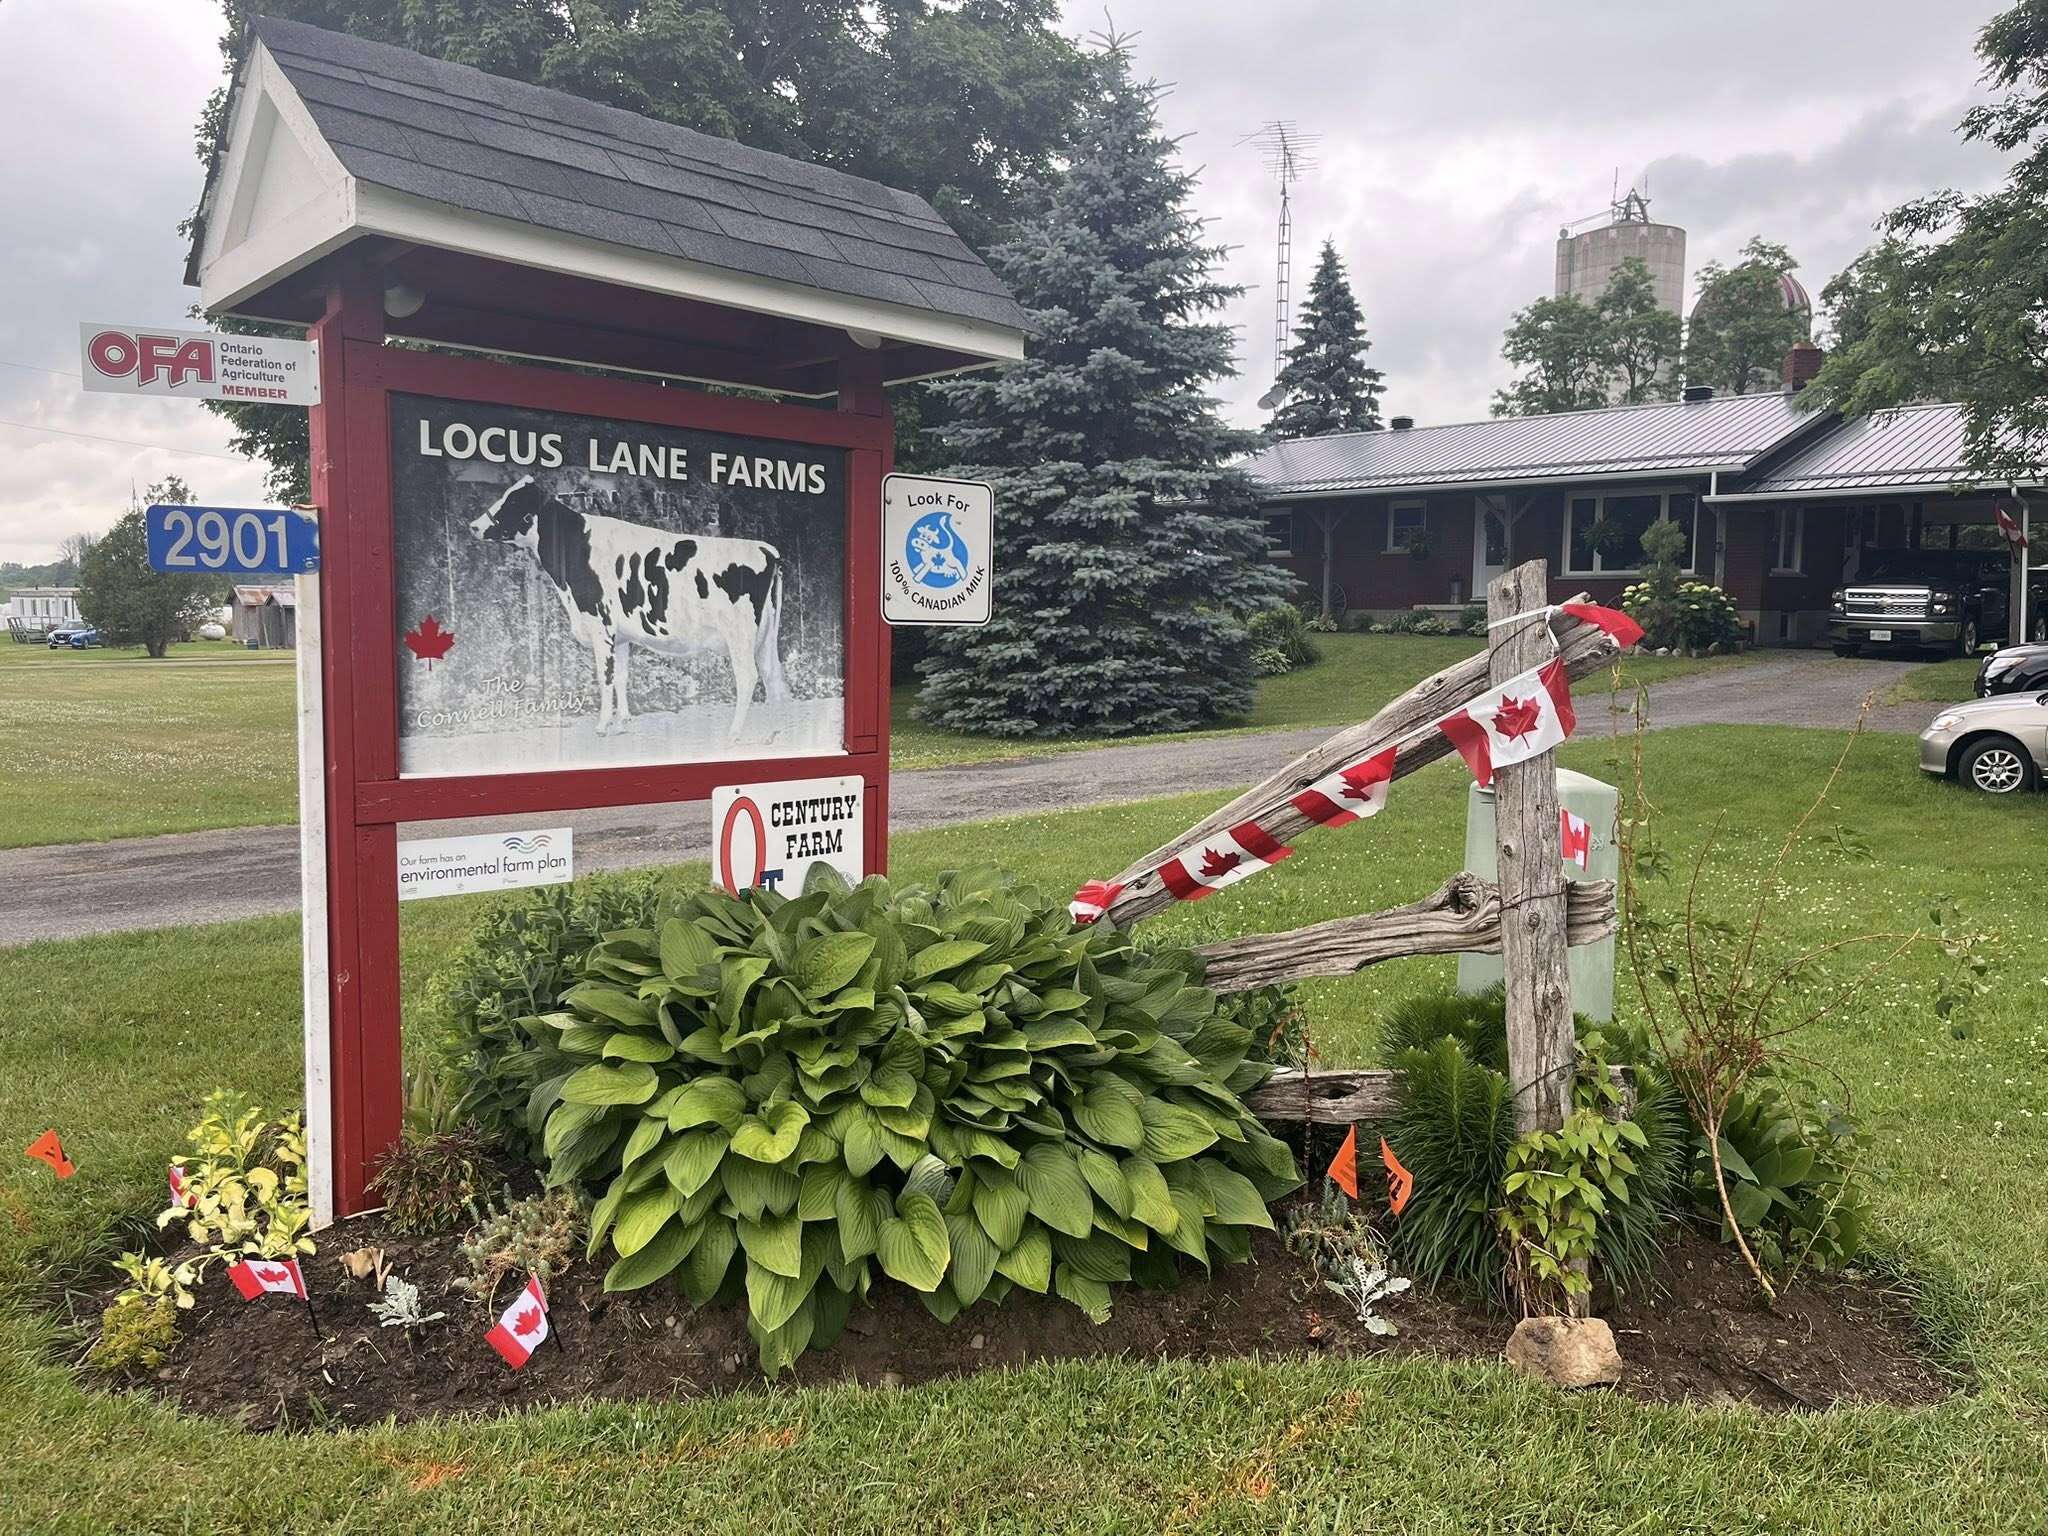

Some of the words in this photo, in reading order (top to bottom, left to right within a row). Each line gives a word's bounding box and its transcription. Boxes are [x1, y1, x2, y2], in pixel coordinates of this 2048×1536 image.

[88, 331, 216, 388] OFA
[220, 342, 263, 355] Ontario
[221, 355, 282, 370] Federation
[285, 361, 296, 371] of
[222, 368, 285, 383] Agriculture
[222, 385, 288, 399] MEMBER
[419, 419, 564, 468] LOCUS
[589, 438, 688, 480] LANE
[710, 452, 827, 494] FARMS
[907, 492, 943, 507] Look
[947, 494, 970, 512] For
[163, 510, 288, 568] 2901
[890, 559, 910, 595] 100%
[911, 592, 966, 611] CANADIAN
[967, 565, 985, 597] MILK
[482, 676, 525, 694] The
[417, 700, 506, 728] Connell
[513, 692, 586, 719] Family
[771, 795, 856, 827] CENTURY
[786, 829, 843, 859] FARM
[400, 856, 417, 866] Our
[419, 854, 438, 864] farm
[439, 853, 454, 863] has
[455, 854, 466, 862] an
[400, 858, 500, 883] environmental
[503, 856, 534, 873] farm
[538, 853, 567, 873] plan
